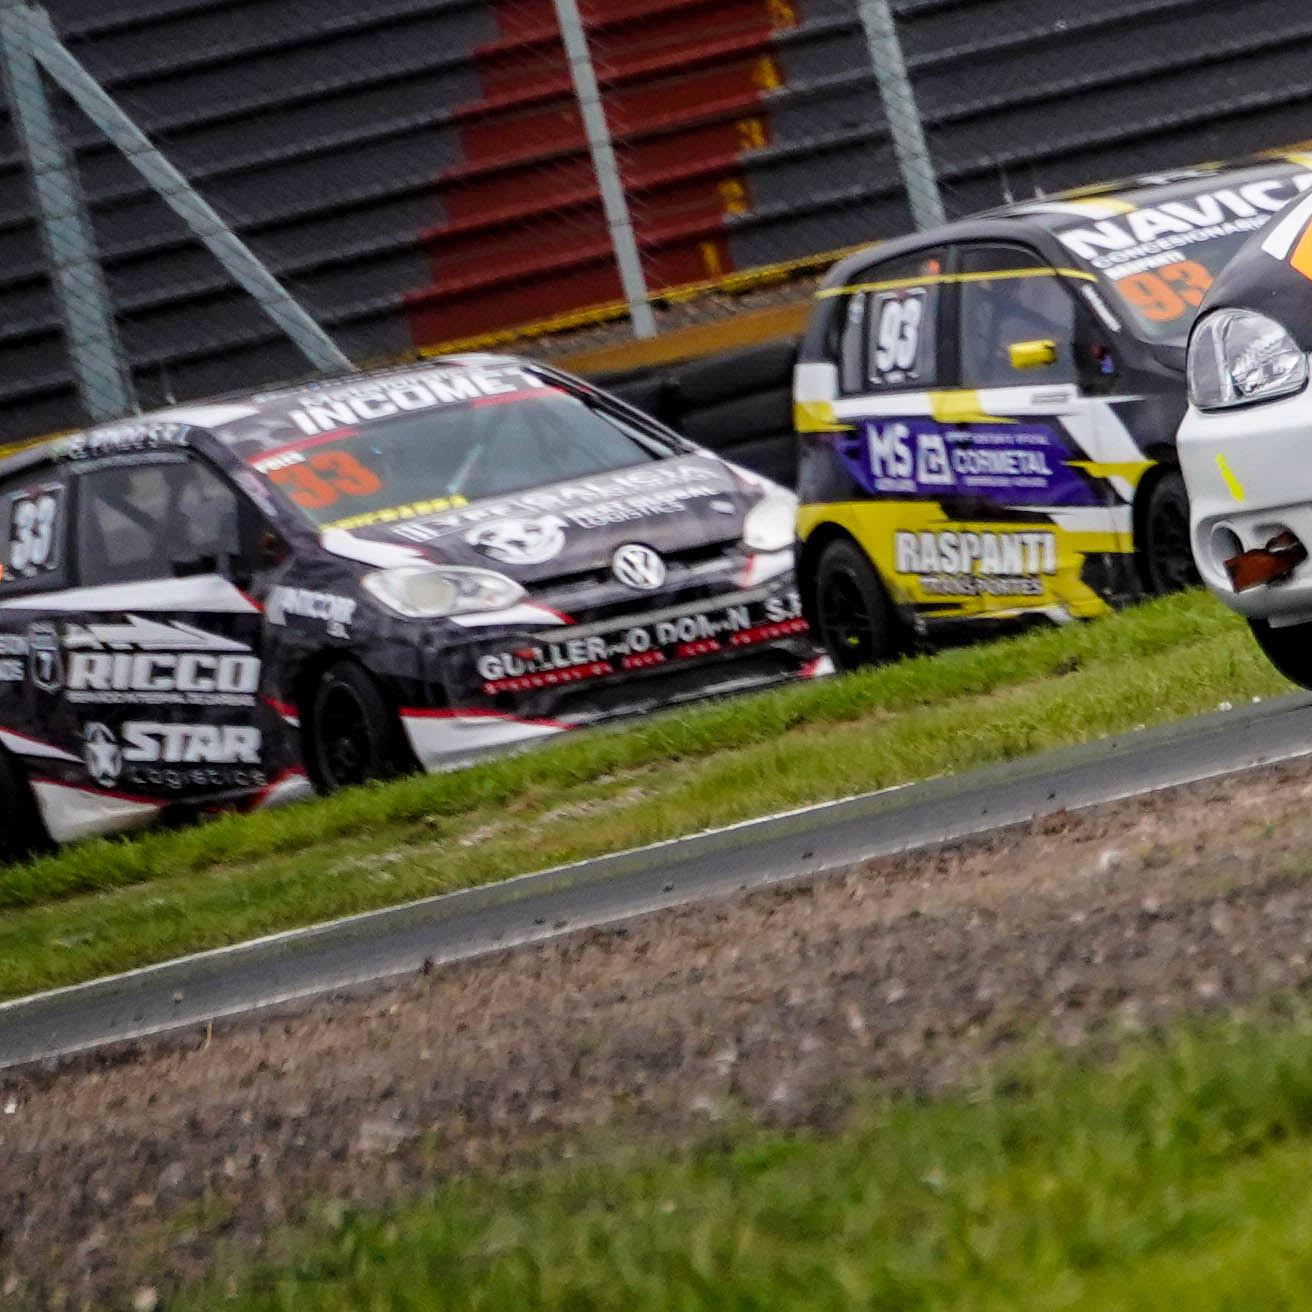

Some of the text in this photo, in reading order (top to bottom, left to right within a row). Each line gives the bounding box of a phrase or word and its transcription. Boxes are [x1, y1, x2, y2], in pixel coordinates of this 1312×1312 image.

[1115, 258, 1214, 322] 93
[876, 297, 922, 373] 93
[266, 450, 384, 510] 33
[10, 495, 56, 572] 33
[896, 530, 1057, 575] RASPANTI
[65, 652, 262, 693] RICCO
[121, 720, 263, 765] STAR
